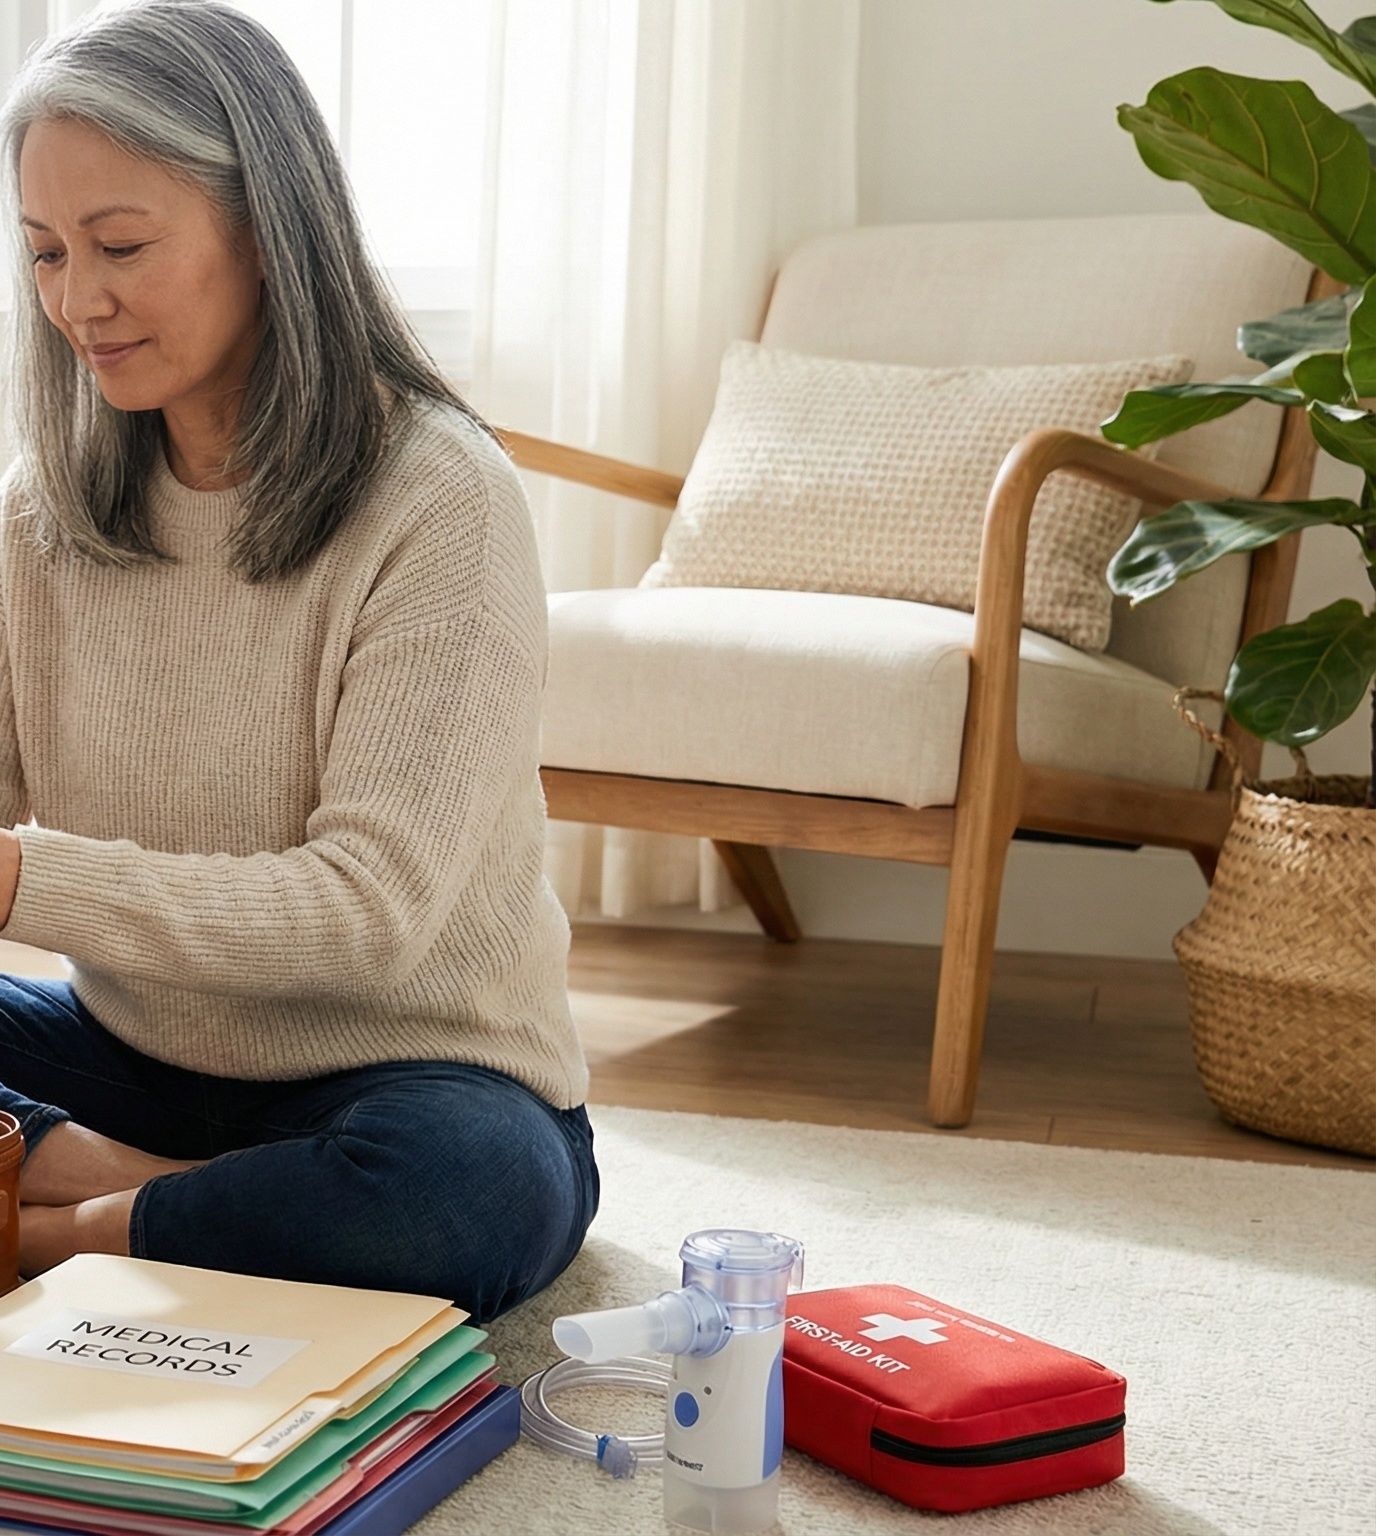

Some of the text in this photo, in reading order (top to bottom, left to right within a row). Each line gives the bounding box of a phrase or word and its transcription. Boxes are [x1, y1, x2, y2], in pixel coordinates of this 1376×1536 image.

[72, 1320, 253, 1357] MEDICAL
[784, 1315, 873, 1357] FIRST-AID
[866, 1353, 911, 1374] KIT
[46, 1339, 243, 1377] RECORDS
